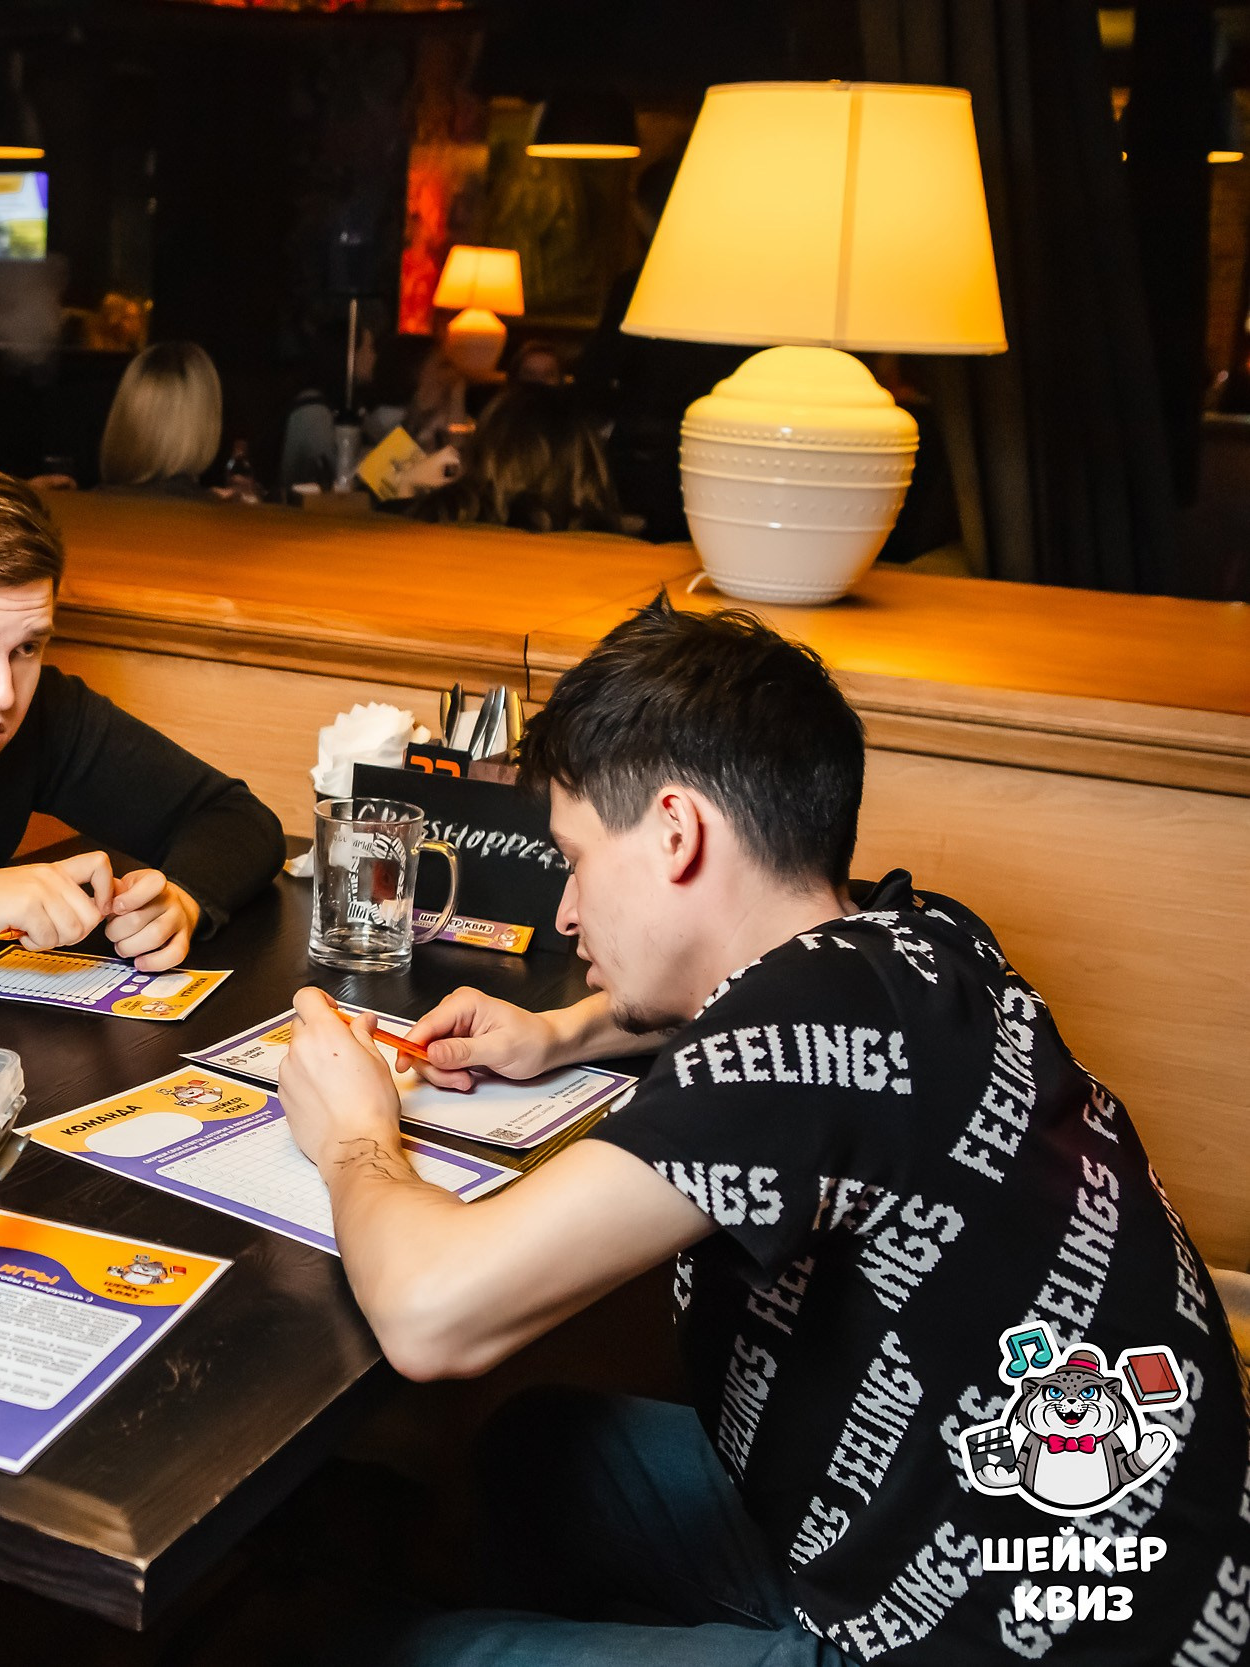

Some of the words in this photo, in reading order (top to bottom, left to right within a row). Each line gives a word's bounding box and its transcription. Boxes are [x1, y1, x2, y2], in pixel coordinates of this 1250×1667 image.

[464, 921, 494, 934] КВИЗ
[207, 1096, 242, 1113] ШЕЙКЕР
[223, 1102, 249, 1114] КВИЗ
[60, 1104, 143, 1136] КОМАНДА
[0, 1264, 60, 1285] ИГРЫ
[35, 1283, 84, 1302] нарушать
